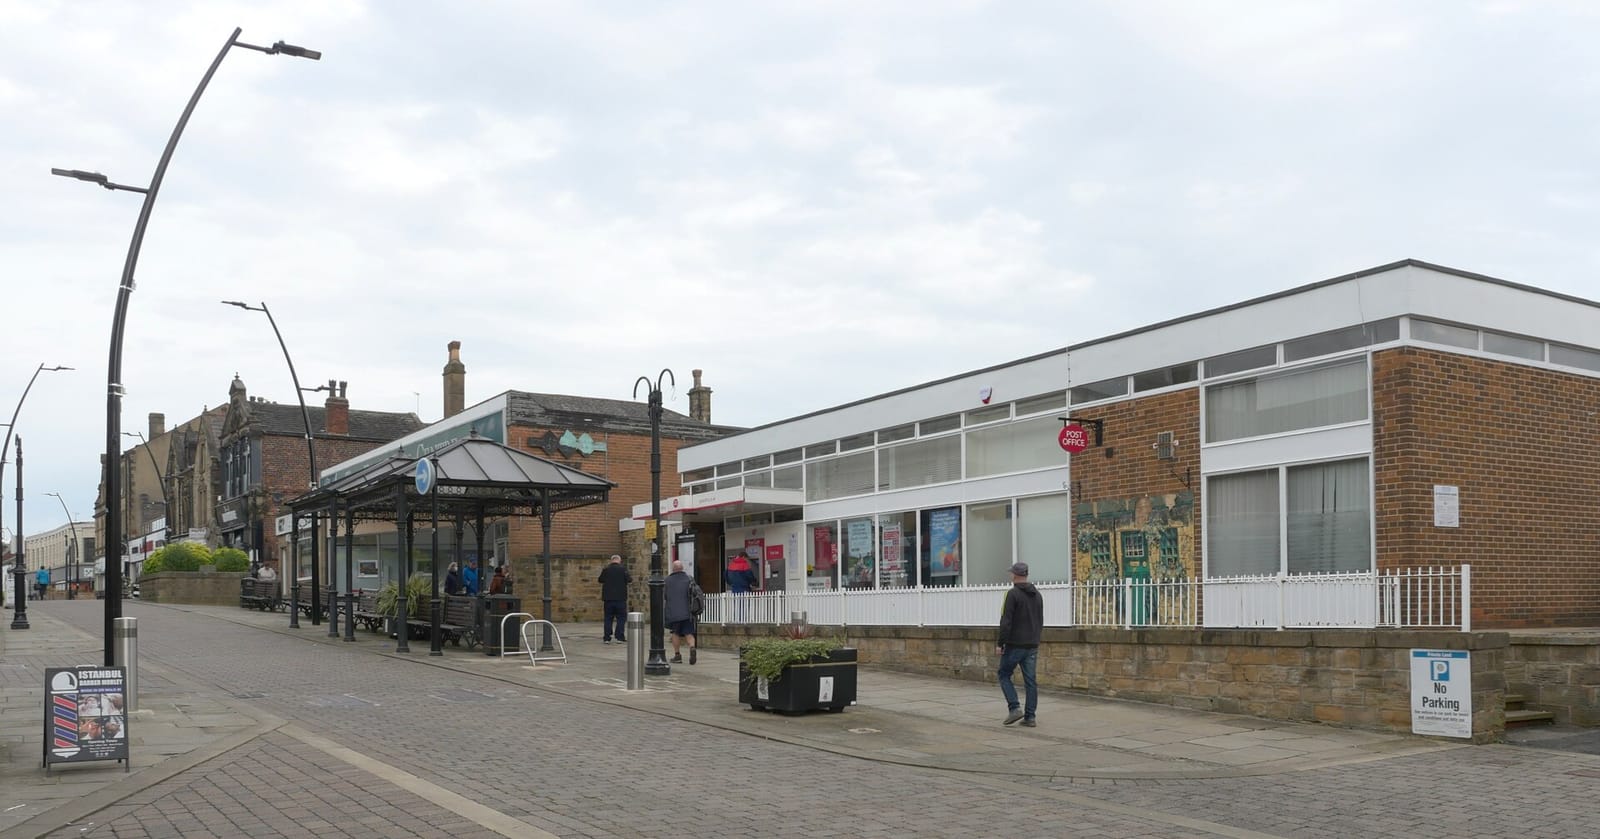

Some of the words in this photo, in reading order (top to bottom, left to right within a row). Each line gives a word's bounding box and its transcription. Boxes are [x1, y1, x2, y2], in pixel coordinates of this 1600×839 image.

[1062, 438, 1085, 447] OFFICE
[79, 670, 123, 679] ISTANBUL
[1434, 682, 1447, 694] No
[1422, 696, 1460, 712] Parking
